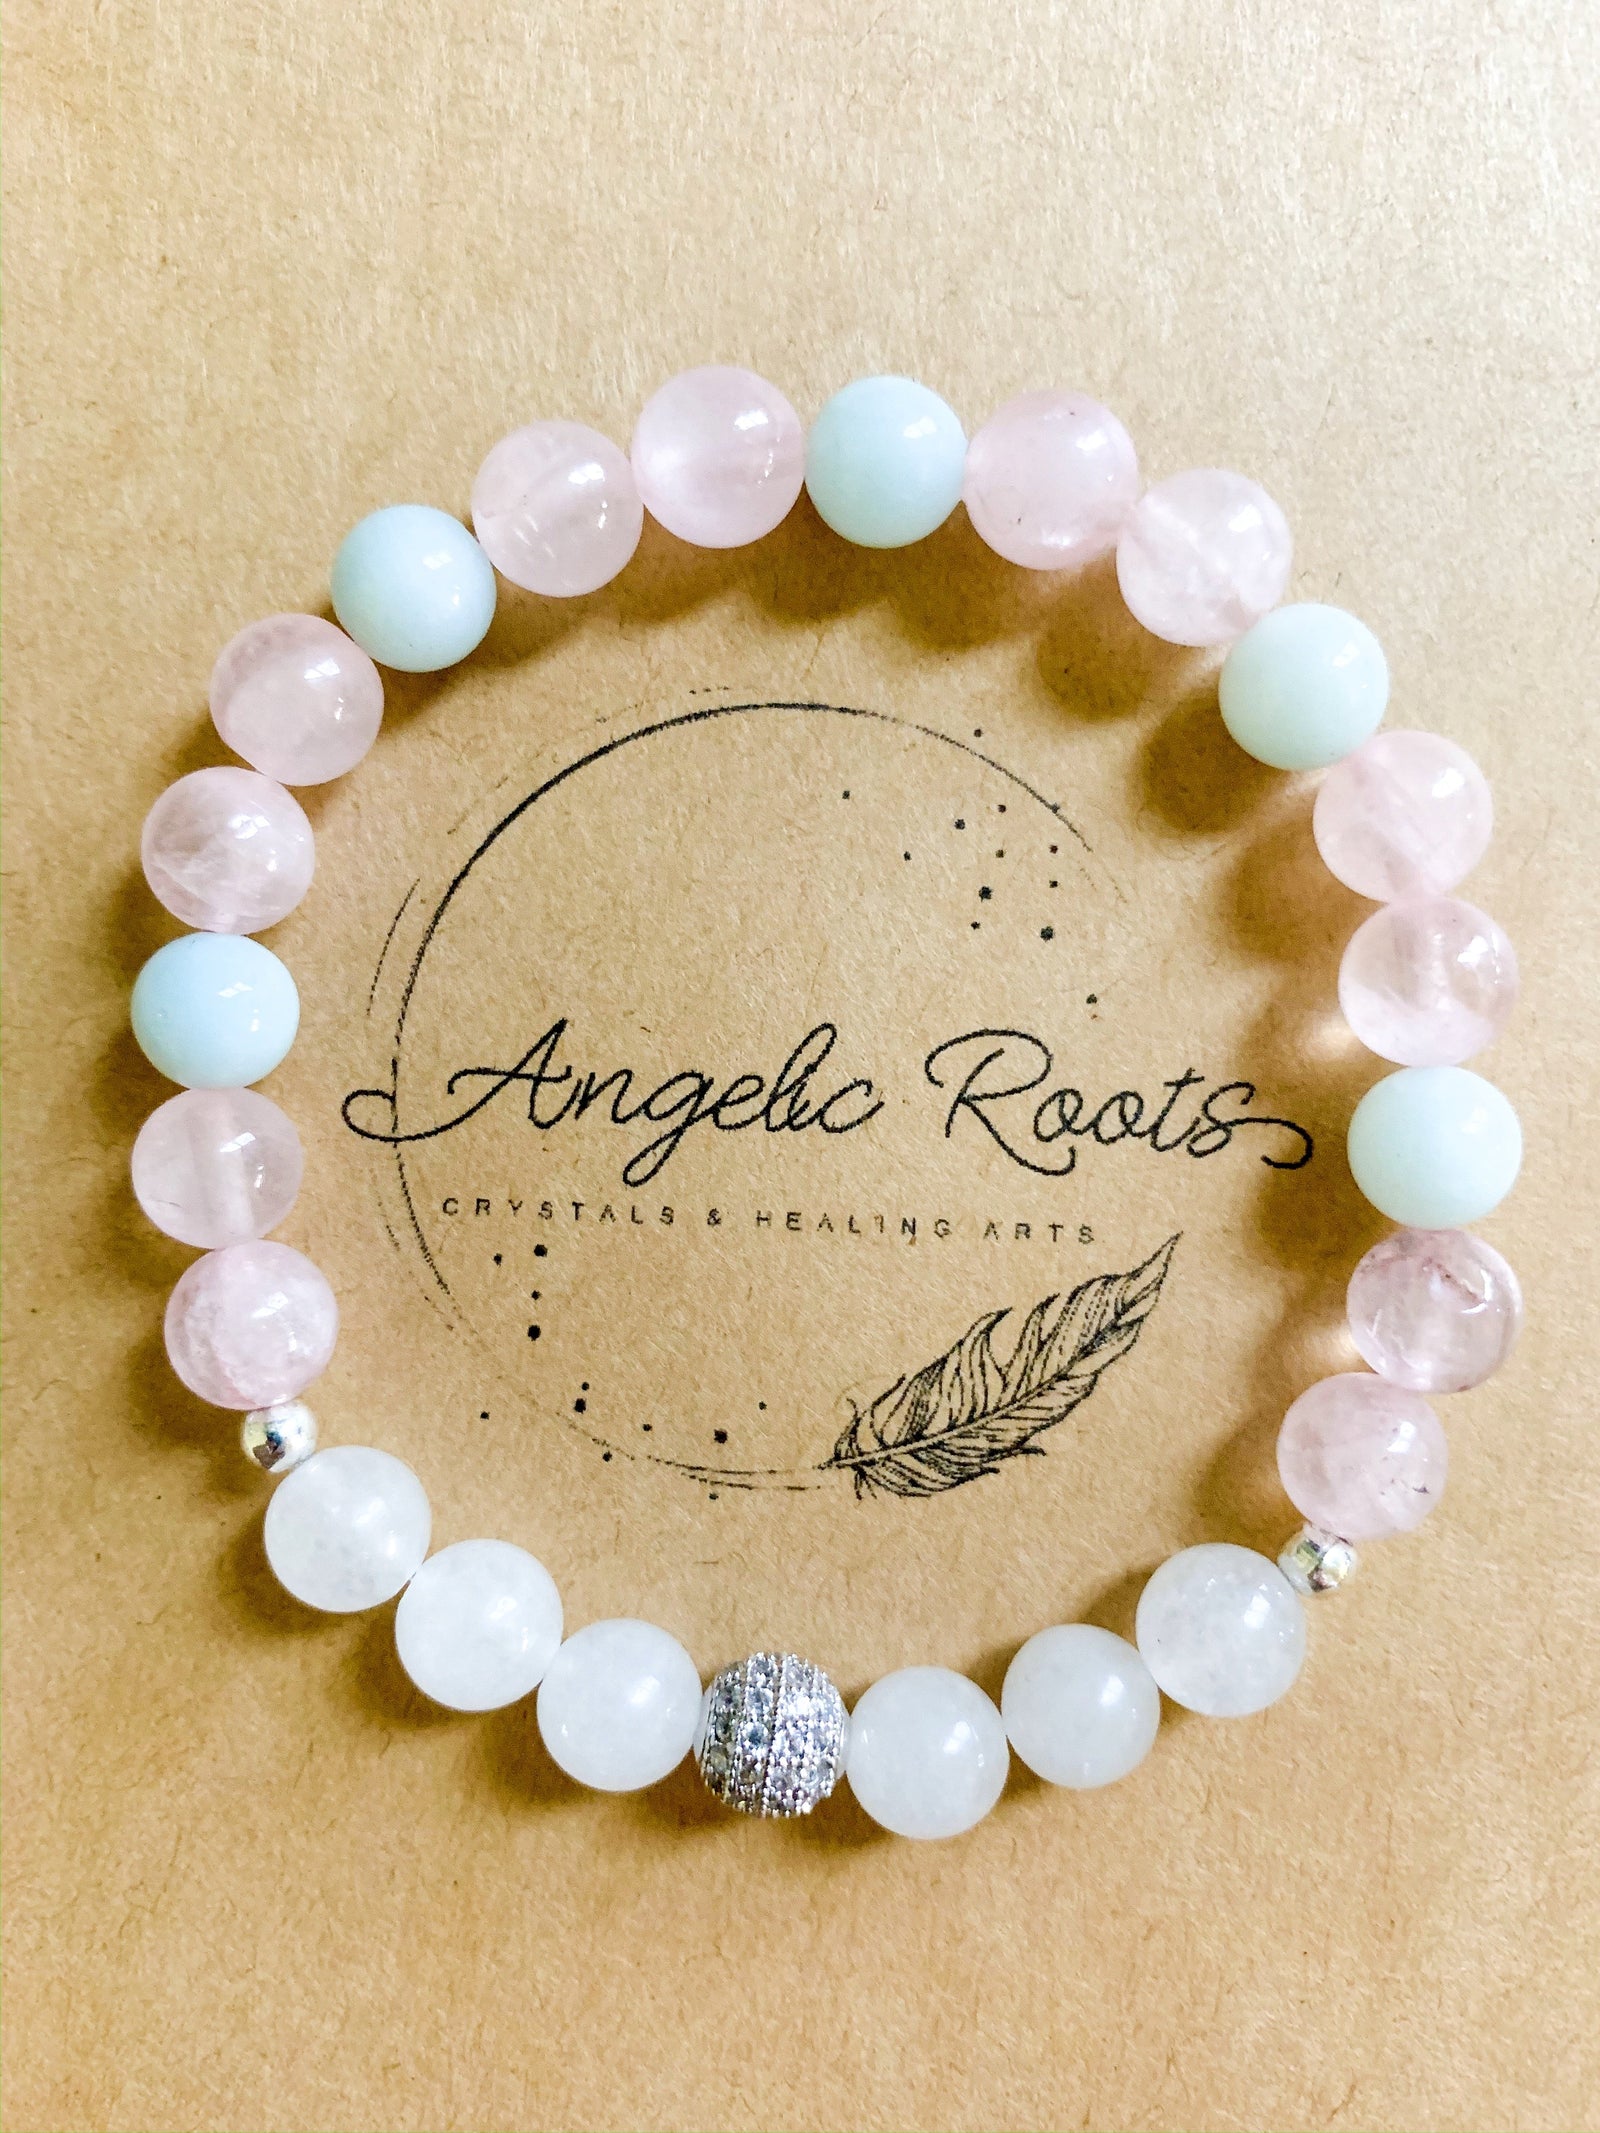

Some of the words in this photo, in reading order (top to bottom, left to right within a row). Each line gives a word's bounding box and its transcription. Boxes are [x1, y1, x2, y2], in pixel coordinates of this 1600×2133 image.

[341, 1017, 885, 1188] Angelic
[924, 1028, 1314, 1176] Roots
[442, 1197, 675, 1226] CRYSTALS
[706, 1208, 723, 1227] &
[755, 1209, 952, 1239] HEALING
[983, 1220, 1096, 1245] ARTS
